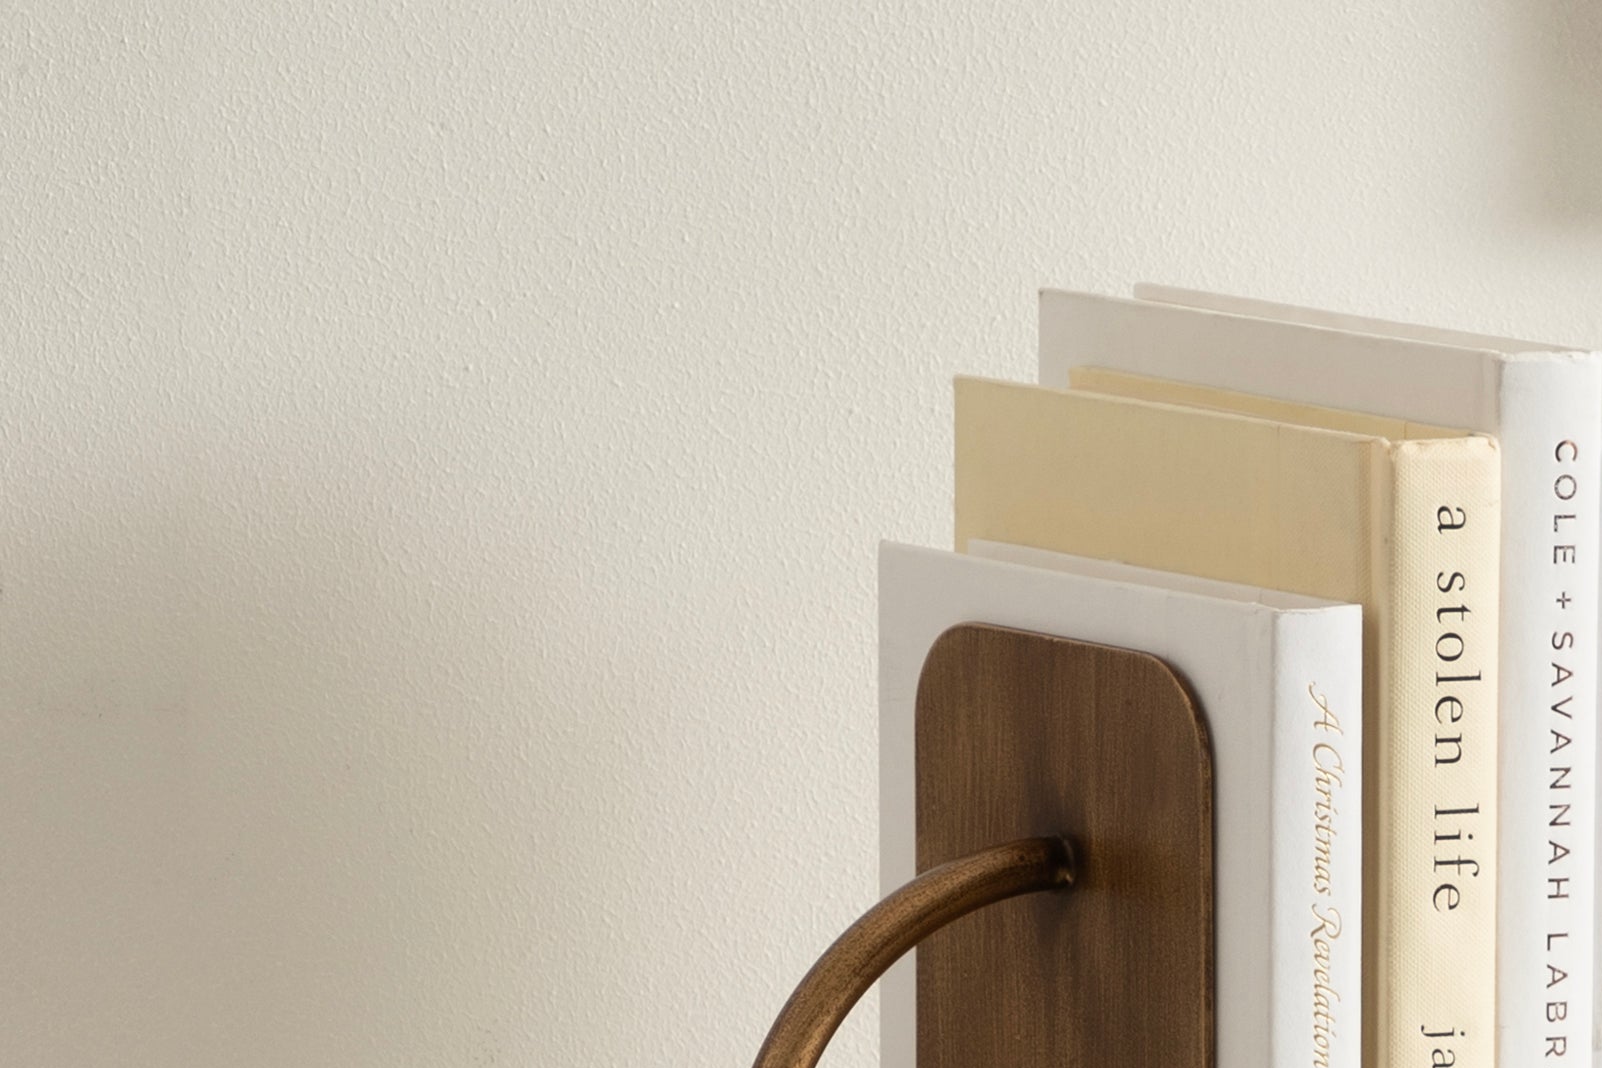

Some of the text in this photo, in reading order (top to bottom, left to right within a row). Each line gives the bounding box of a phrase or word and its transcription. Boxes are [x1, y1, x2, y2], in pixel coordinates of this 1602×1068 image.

[1552, 439, 1578, 565] COLE
[1555, 591, 1572, 610] +
[1308, 681, 1344, 734] A
[1432, 505, 1482, 912] a stolen life
[1548, 631, 1575, 901] SAVANNAH
[1312, 743, 1345, 896] Christmas
